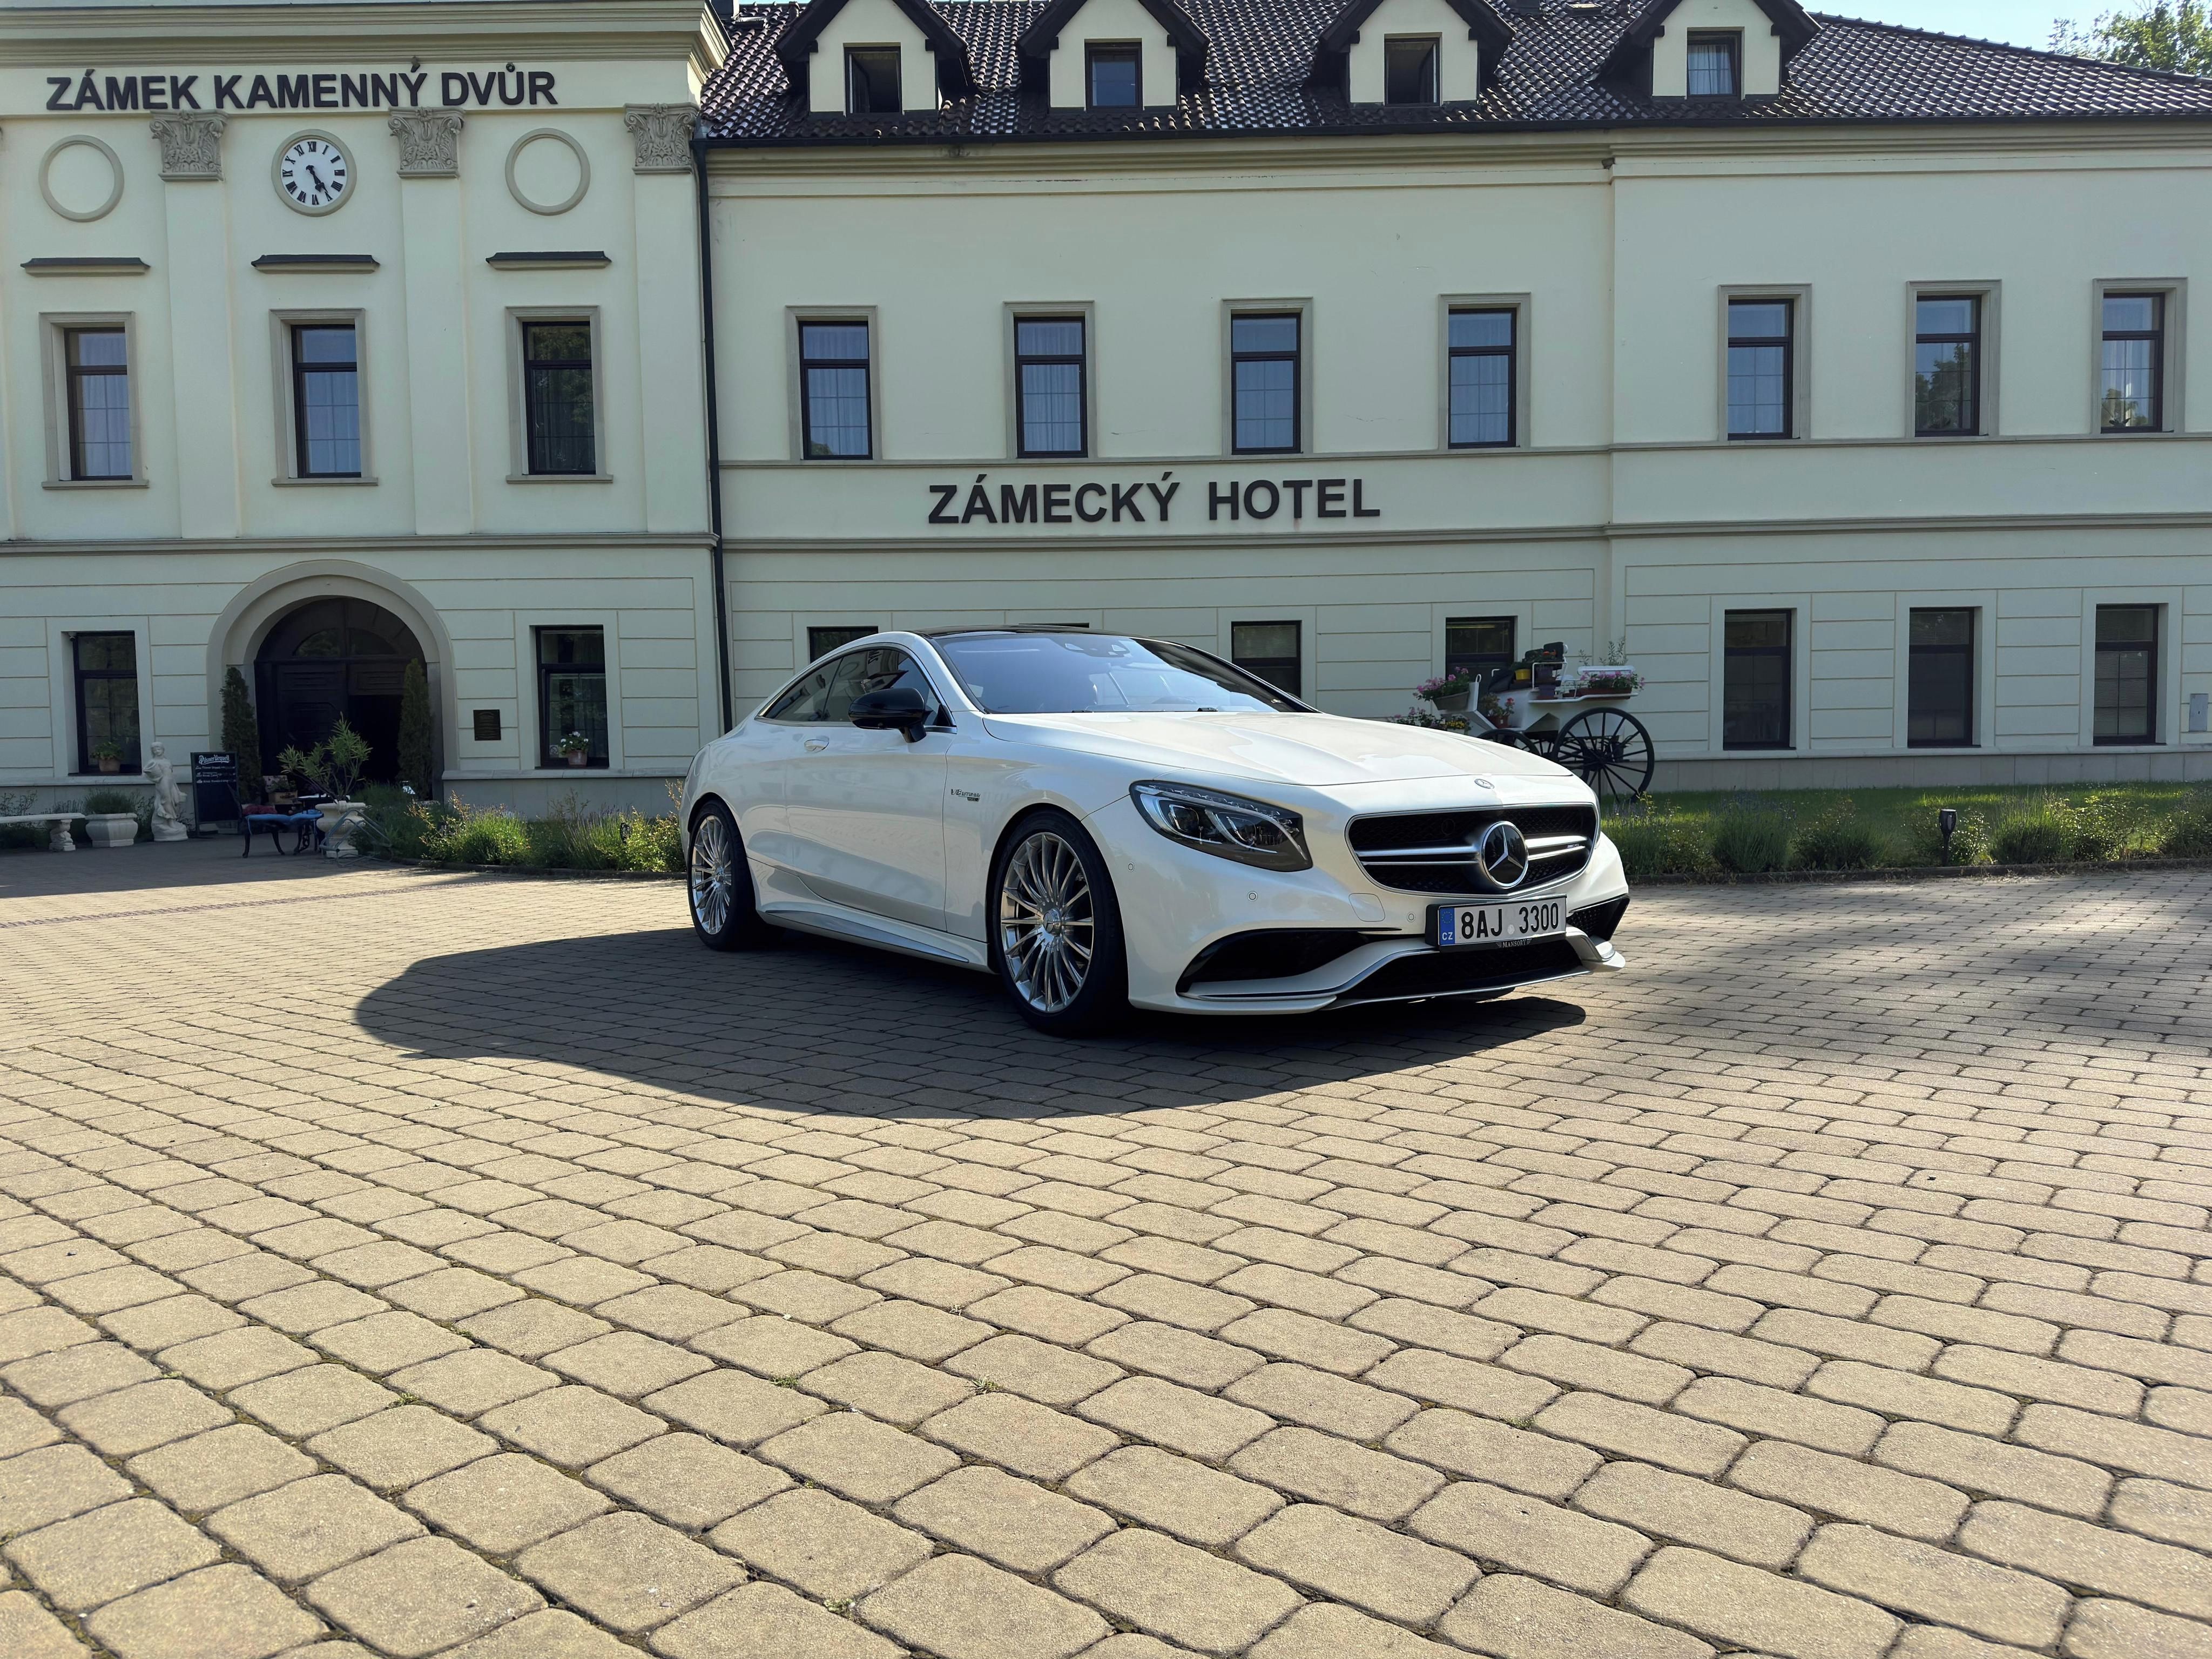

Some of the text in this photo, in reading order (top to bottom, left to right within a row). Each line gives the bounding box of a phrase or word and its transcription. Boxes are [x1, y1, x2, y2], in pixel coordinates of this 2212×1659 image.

[46, 62, 558, 110] ZÁMEK KAMENNÝ DVŮR
[928, 471, 1381, 524] ZÁMECKÝ HOTEL
[198, 754, 230, 765] Pilsner Urquell
[1461, 902, 1559, 940] 8AJ 3300
[1442, 932, 1453, 940] CZ
[1502, 939, 1526, 948] MANSORY
